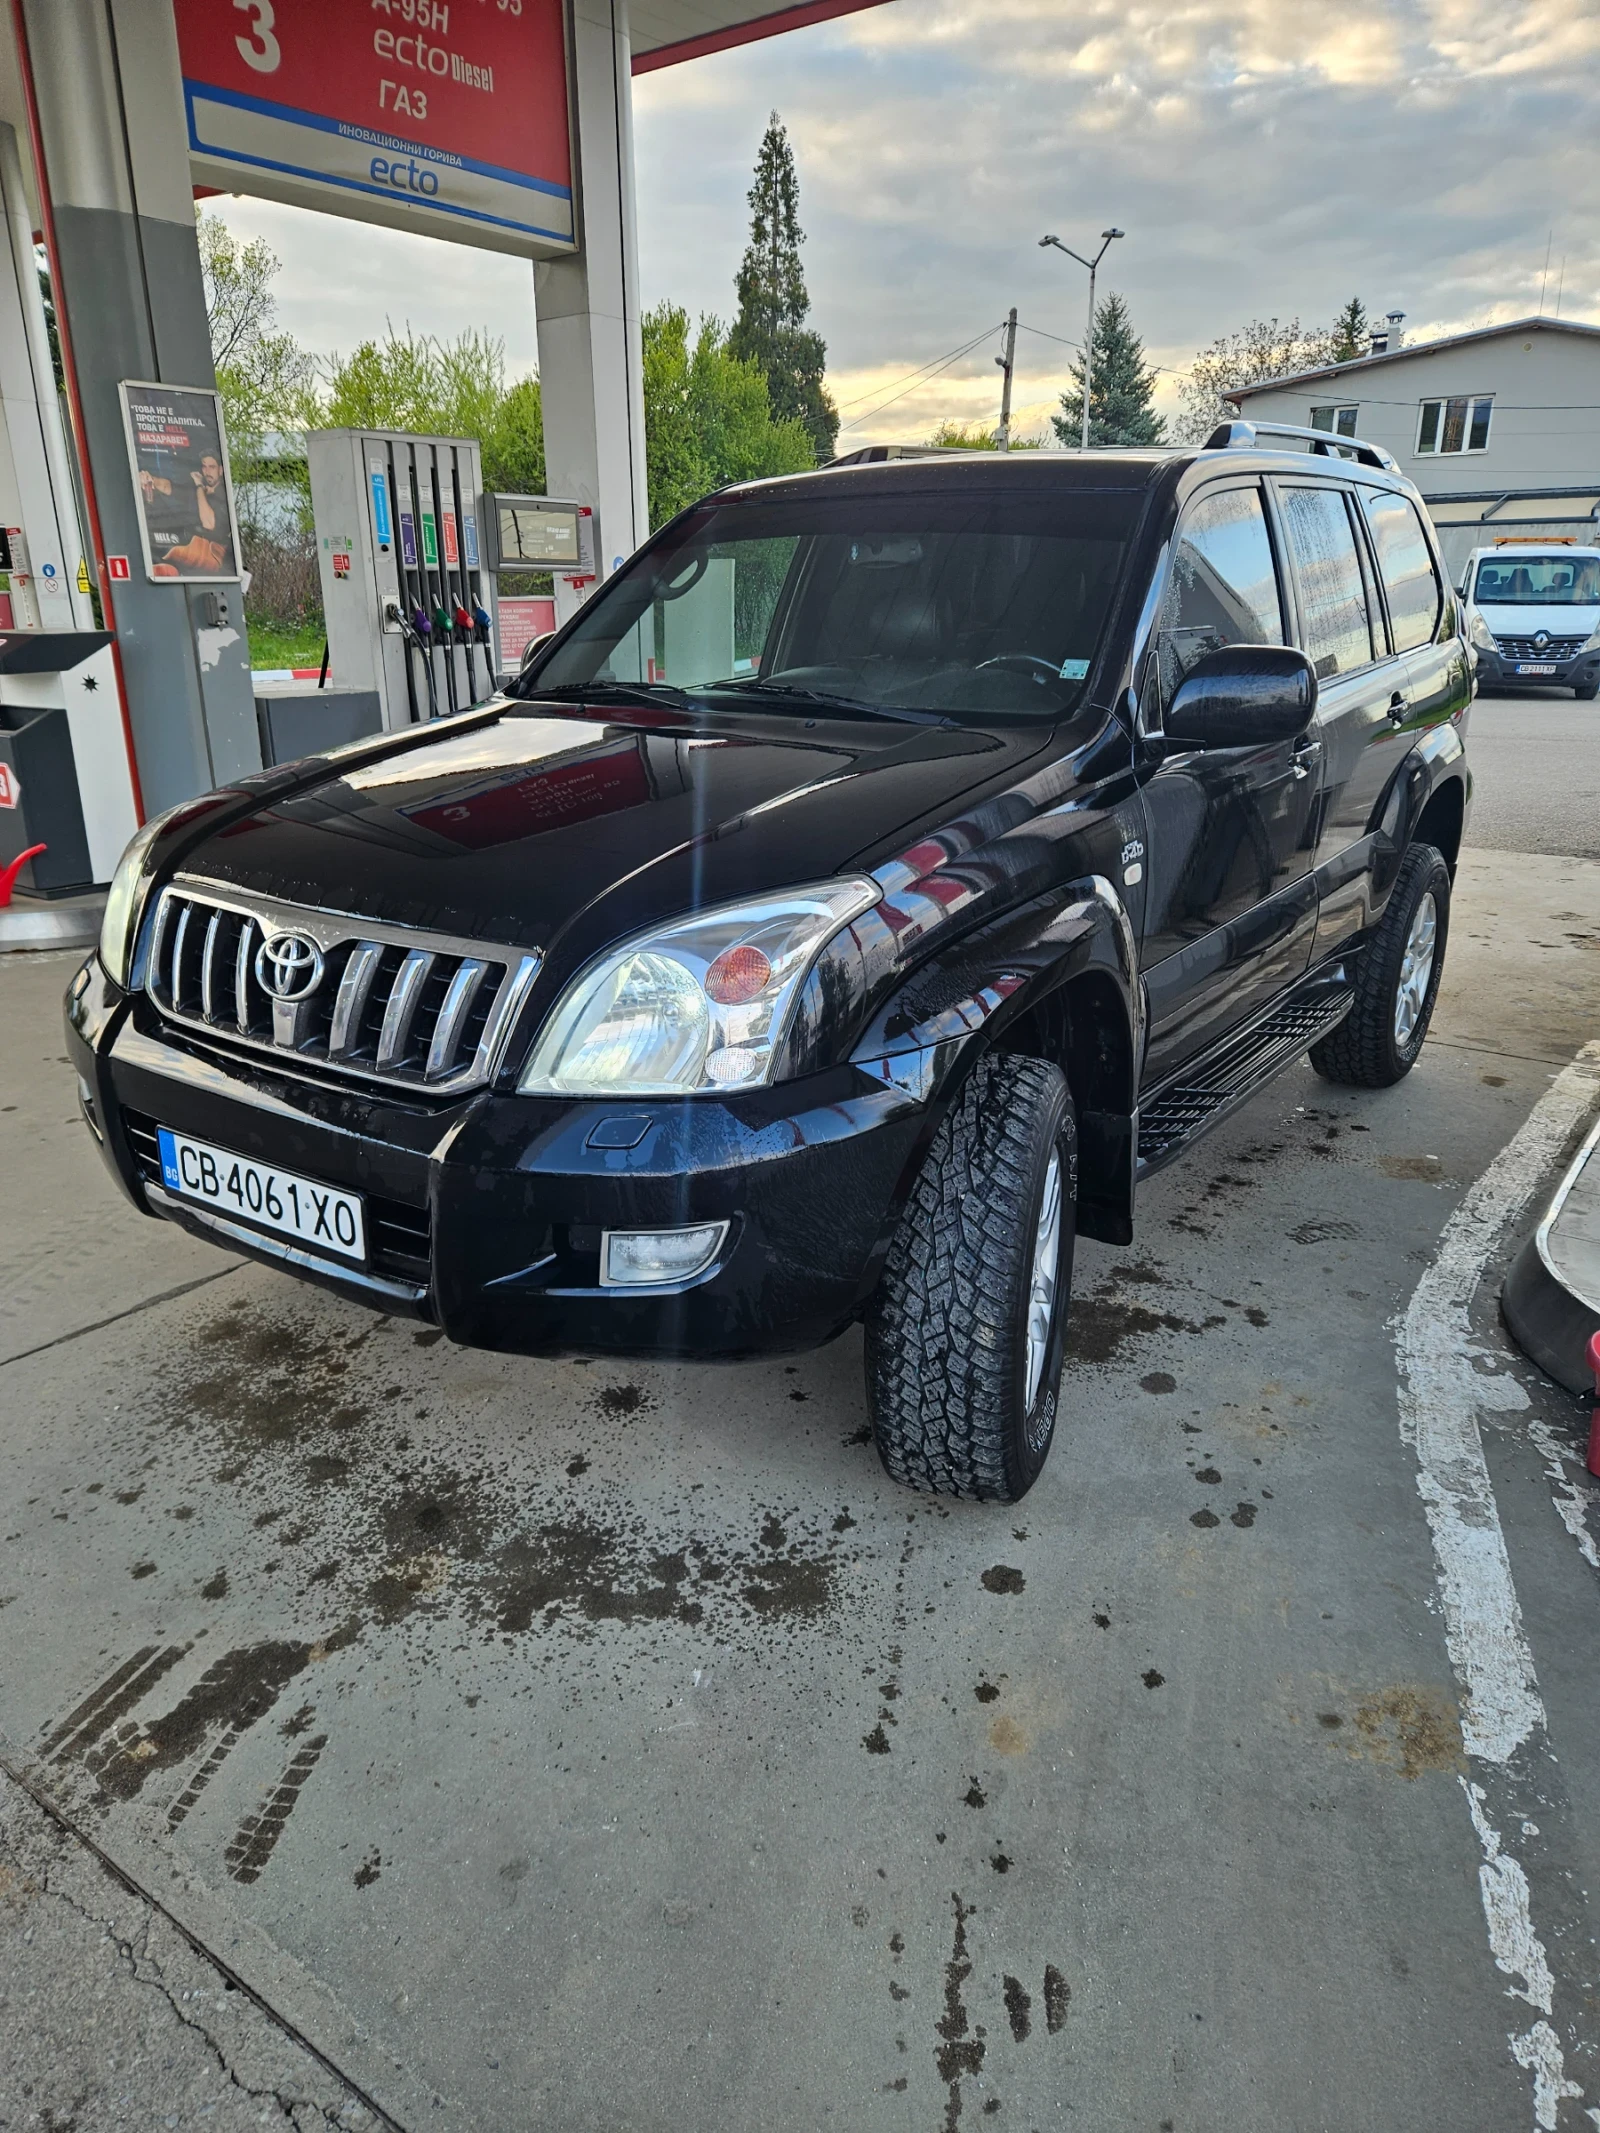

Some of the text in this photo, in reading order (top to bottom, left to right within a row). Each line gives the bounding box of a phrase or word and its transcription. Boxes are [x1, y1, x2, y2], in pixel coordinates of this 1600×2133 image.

[233, 0, 281, 73] 3
[373, 28, 494, 93] ecto Diesel
[378, 79, 428, 120] ГАЗ
[338, 123, 462, 167] ИНОВАЦИОННИ ГОРИВА
[370, 157, 439, 196] ecto
[135, 413, 166, 423] ПРОСТО
[137, 423, 158, 432] ТОВА
[156, 406, 167, 414] НЕ
[165, 1165, 178, 1181] BG
[180, 1145, 356, 1247] CB 4061 XO
